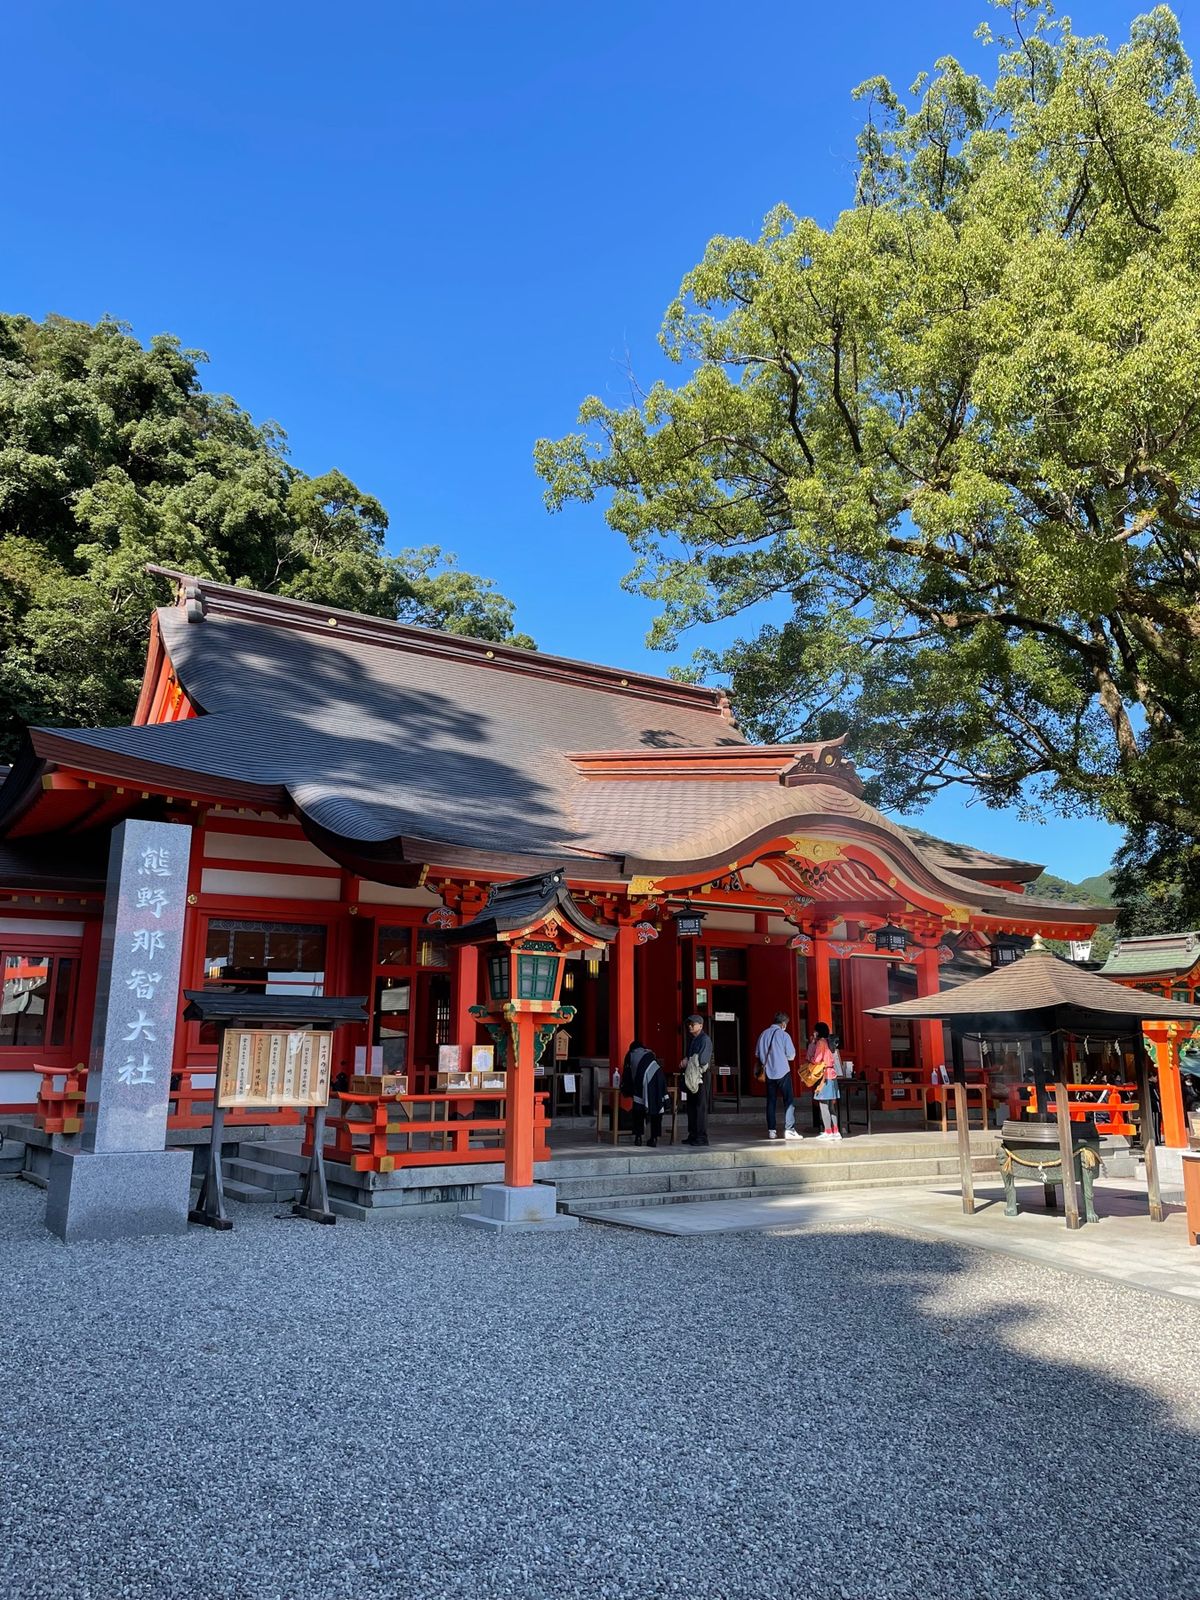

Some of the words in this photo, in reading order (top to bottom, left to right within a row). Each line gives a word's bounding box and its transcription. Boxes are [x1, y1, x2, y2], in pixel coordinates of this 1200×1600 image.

[118, 847, 172, 1085] 熊野那智大社
